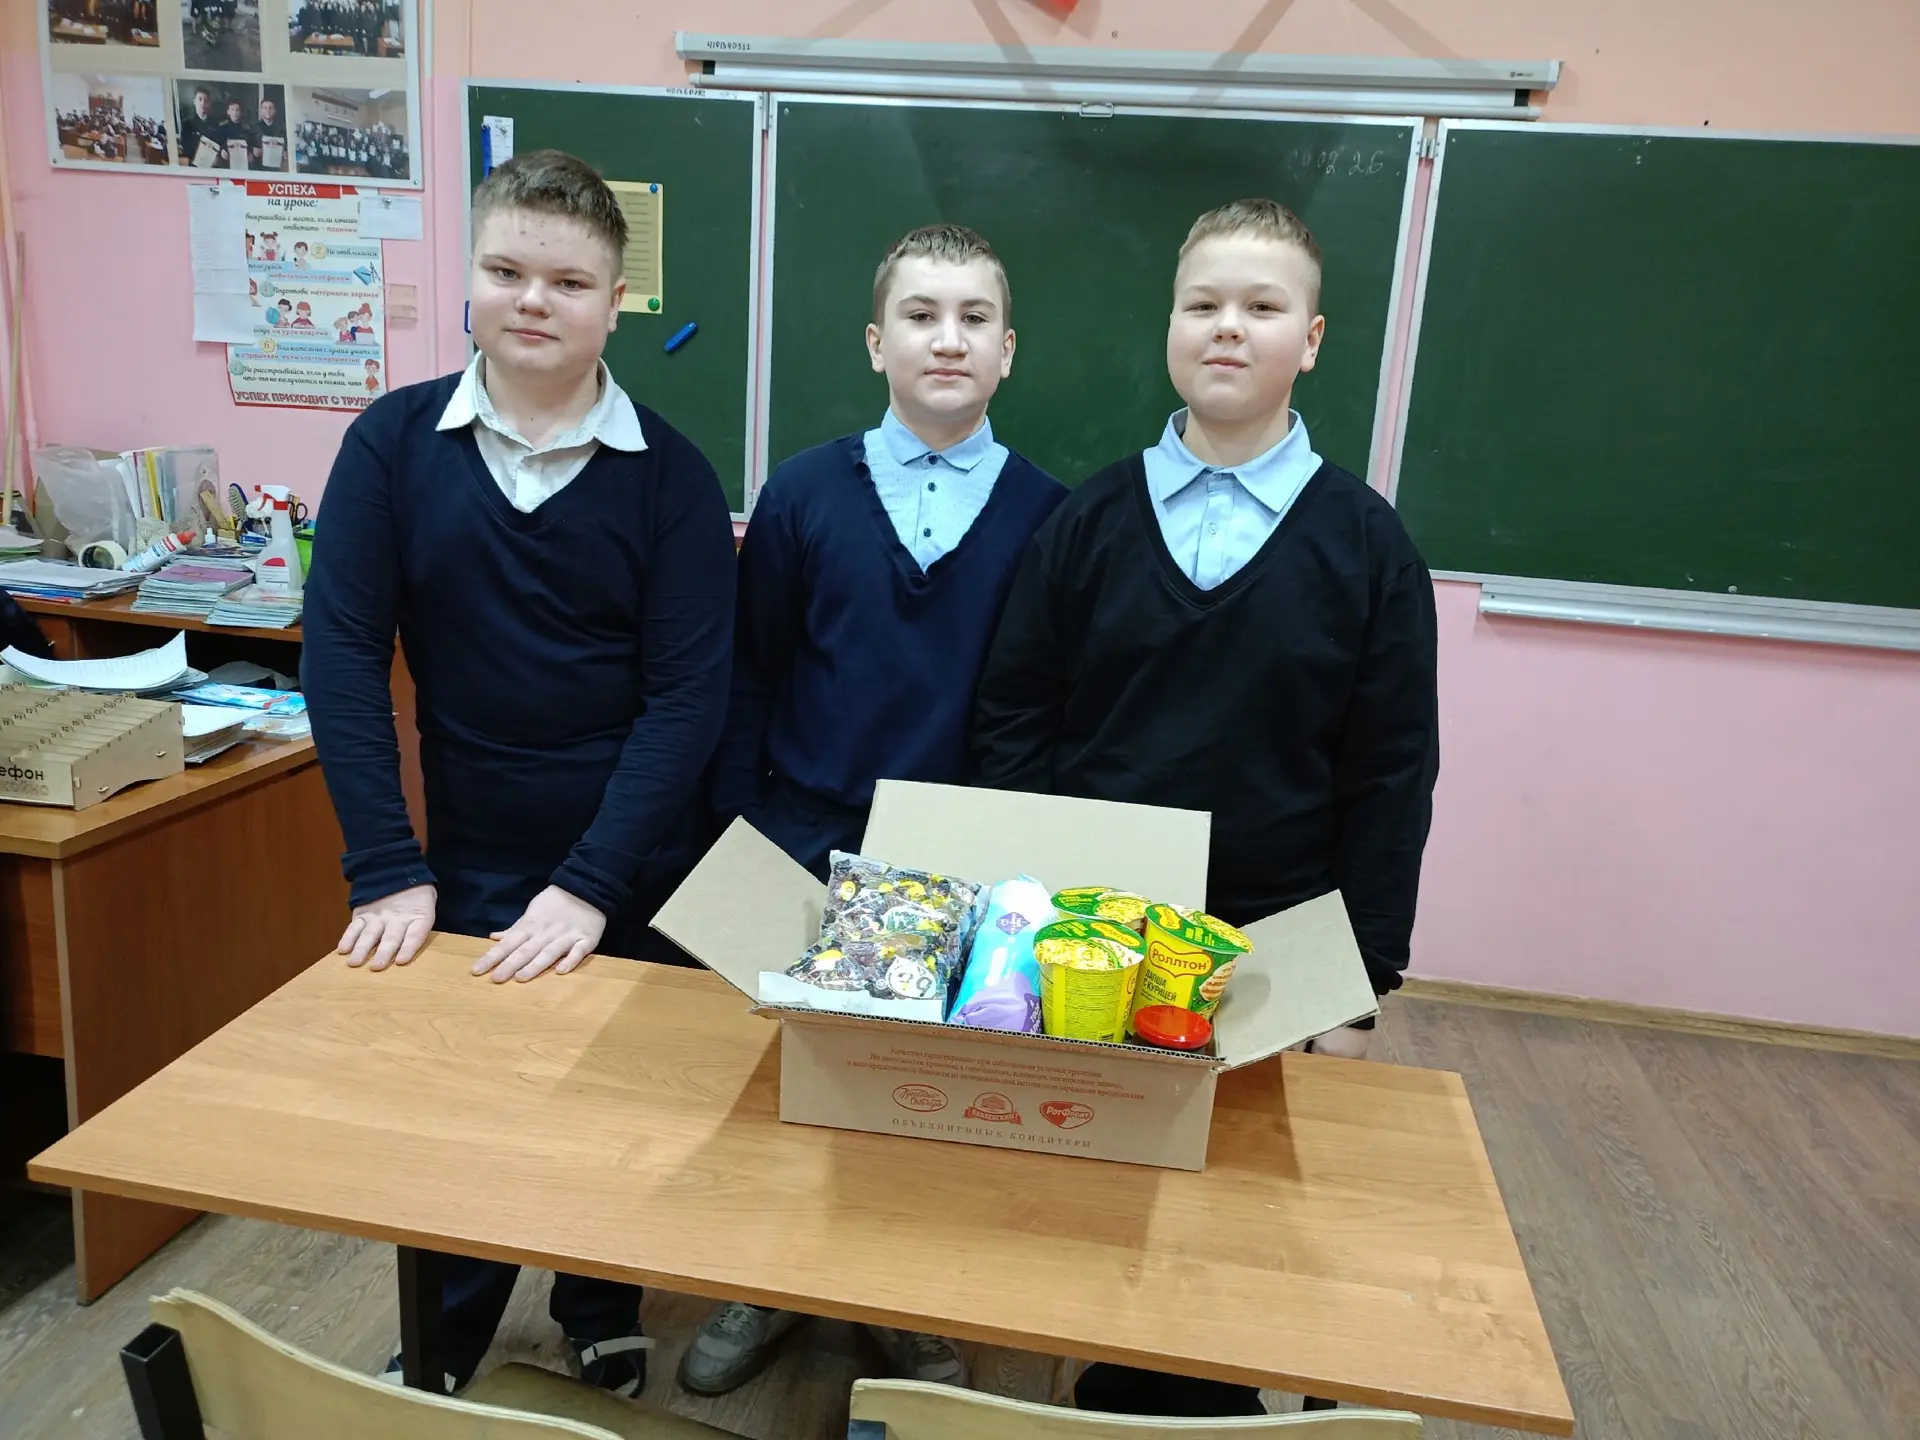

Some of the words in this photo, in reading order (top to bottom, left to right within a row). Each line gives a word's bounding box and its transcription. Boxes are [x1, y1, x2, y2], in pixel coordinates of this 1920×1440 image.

[267, 183, 317, 196] УСПЕХА
[267, 198, 281, 206] на
[235, 391, 271, 401] УСПЕХ
[271, 393, 329, 406] ПРИХОДИТ
[331, 396, 340, 405] С
[1151, 947, 1207, 971] РОЛЛТОН
[1145, 969, 1167, 988] ЛАПША
[1010, 1131, 1091, 1148] КОНДИТЕРЫ
